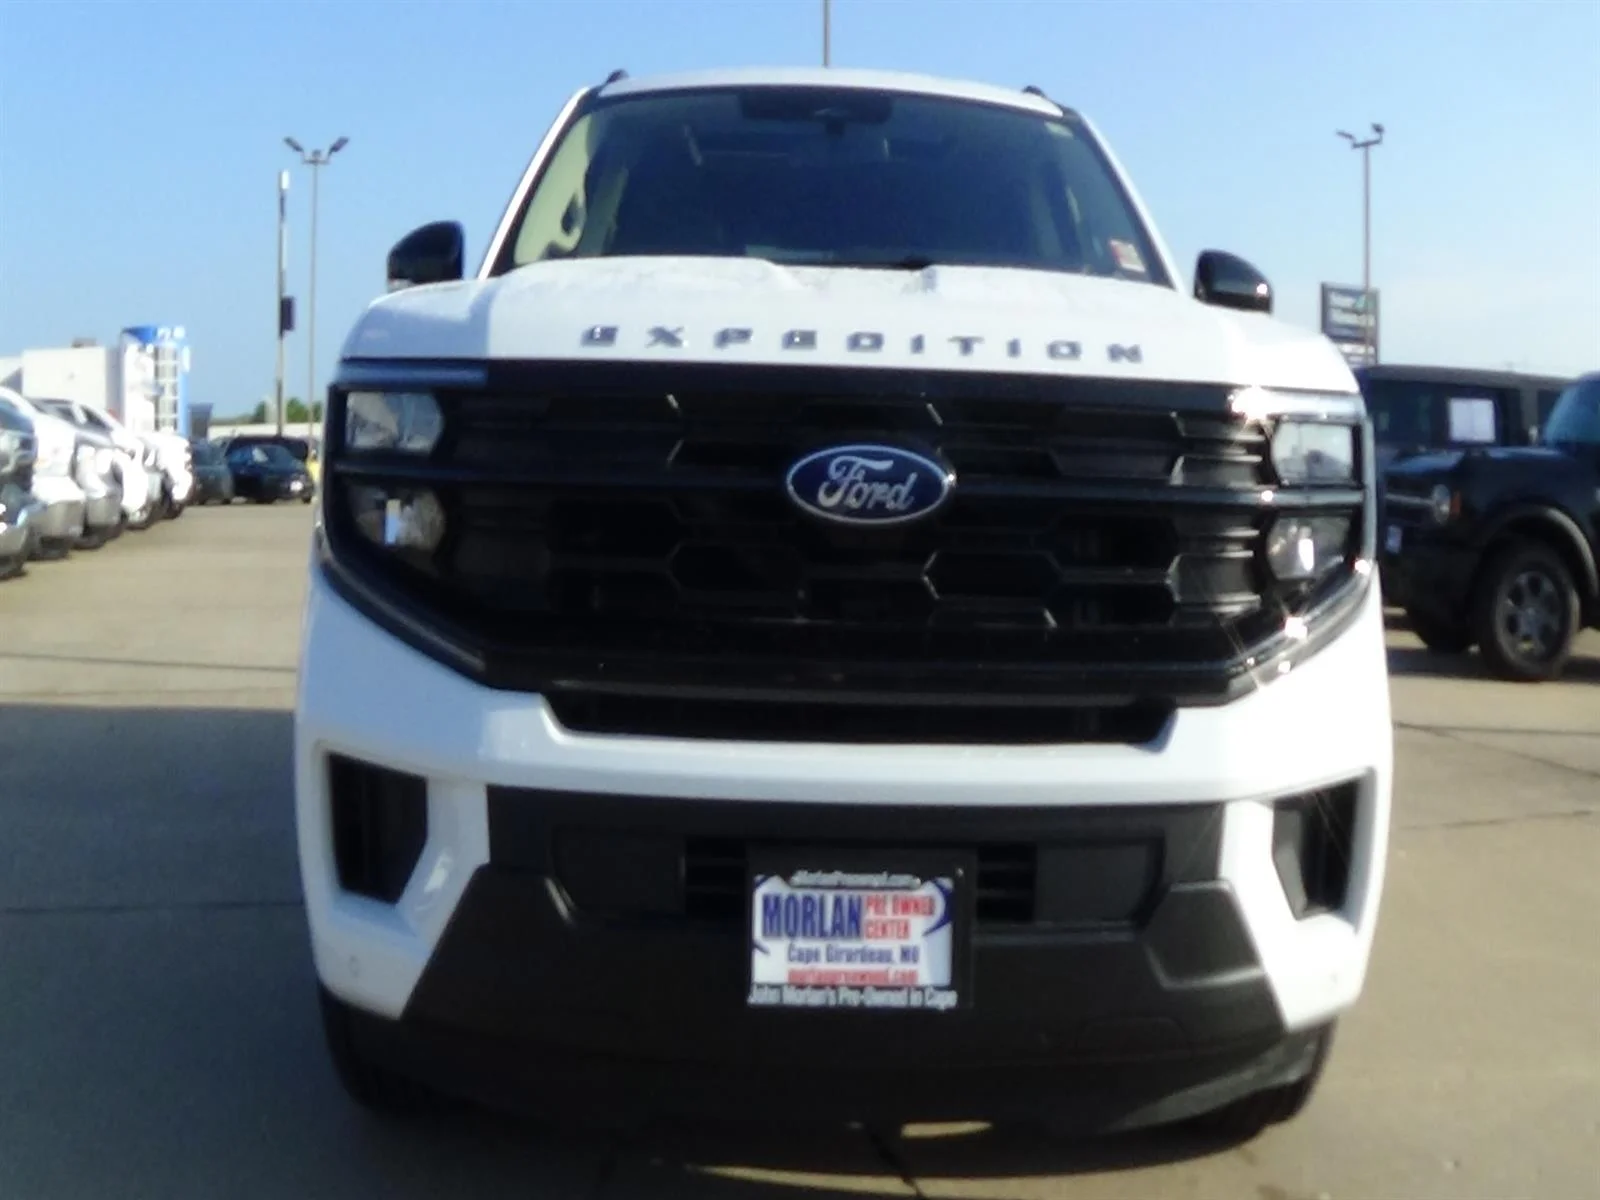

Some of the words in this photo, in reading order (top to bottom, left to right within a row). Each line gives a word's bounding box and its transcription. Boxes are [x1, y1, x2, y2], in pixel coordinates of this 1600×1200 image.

[580, 324, 1143, 363] EXPEDITION
[817, 454, 920, 511] Ford
[762, 894, 862, 938] MORLAN
[866, 894, 887, 916] PRE
[892, 894, 935, 916] OWNED
[865, 919, 909, 939] CENTER
[788, 943, 820, 966] Cape
[900, 944, 920, 964] MO
